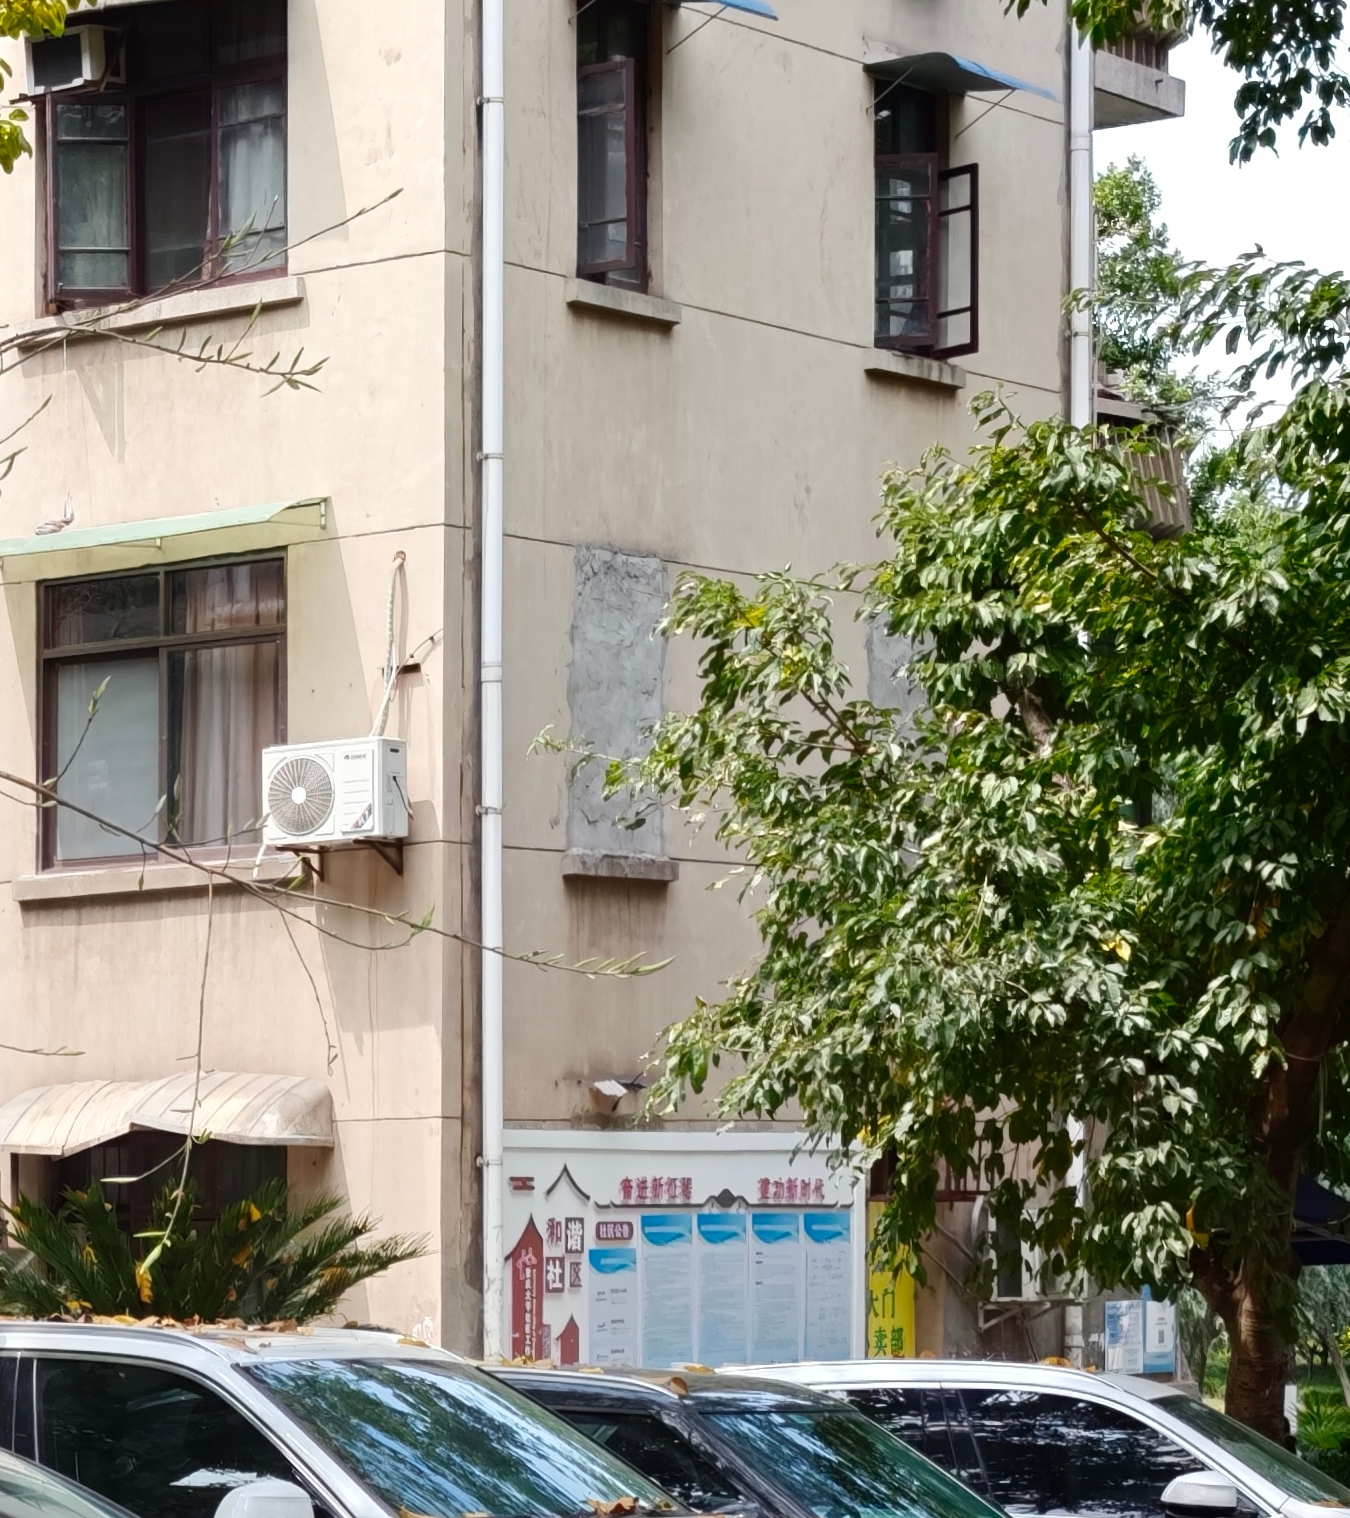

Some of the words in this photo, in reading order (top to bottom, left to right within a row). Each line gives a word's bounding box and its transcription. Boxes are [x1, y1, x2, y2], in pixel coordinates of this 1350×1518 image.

[757, 1177, 825, 1201] 建功新时代
